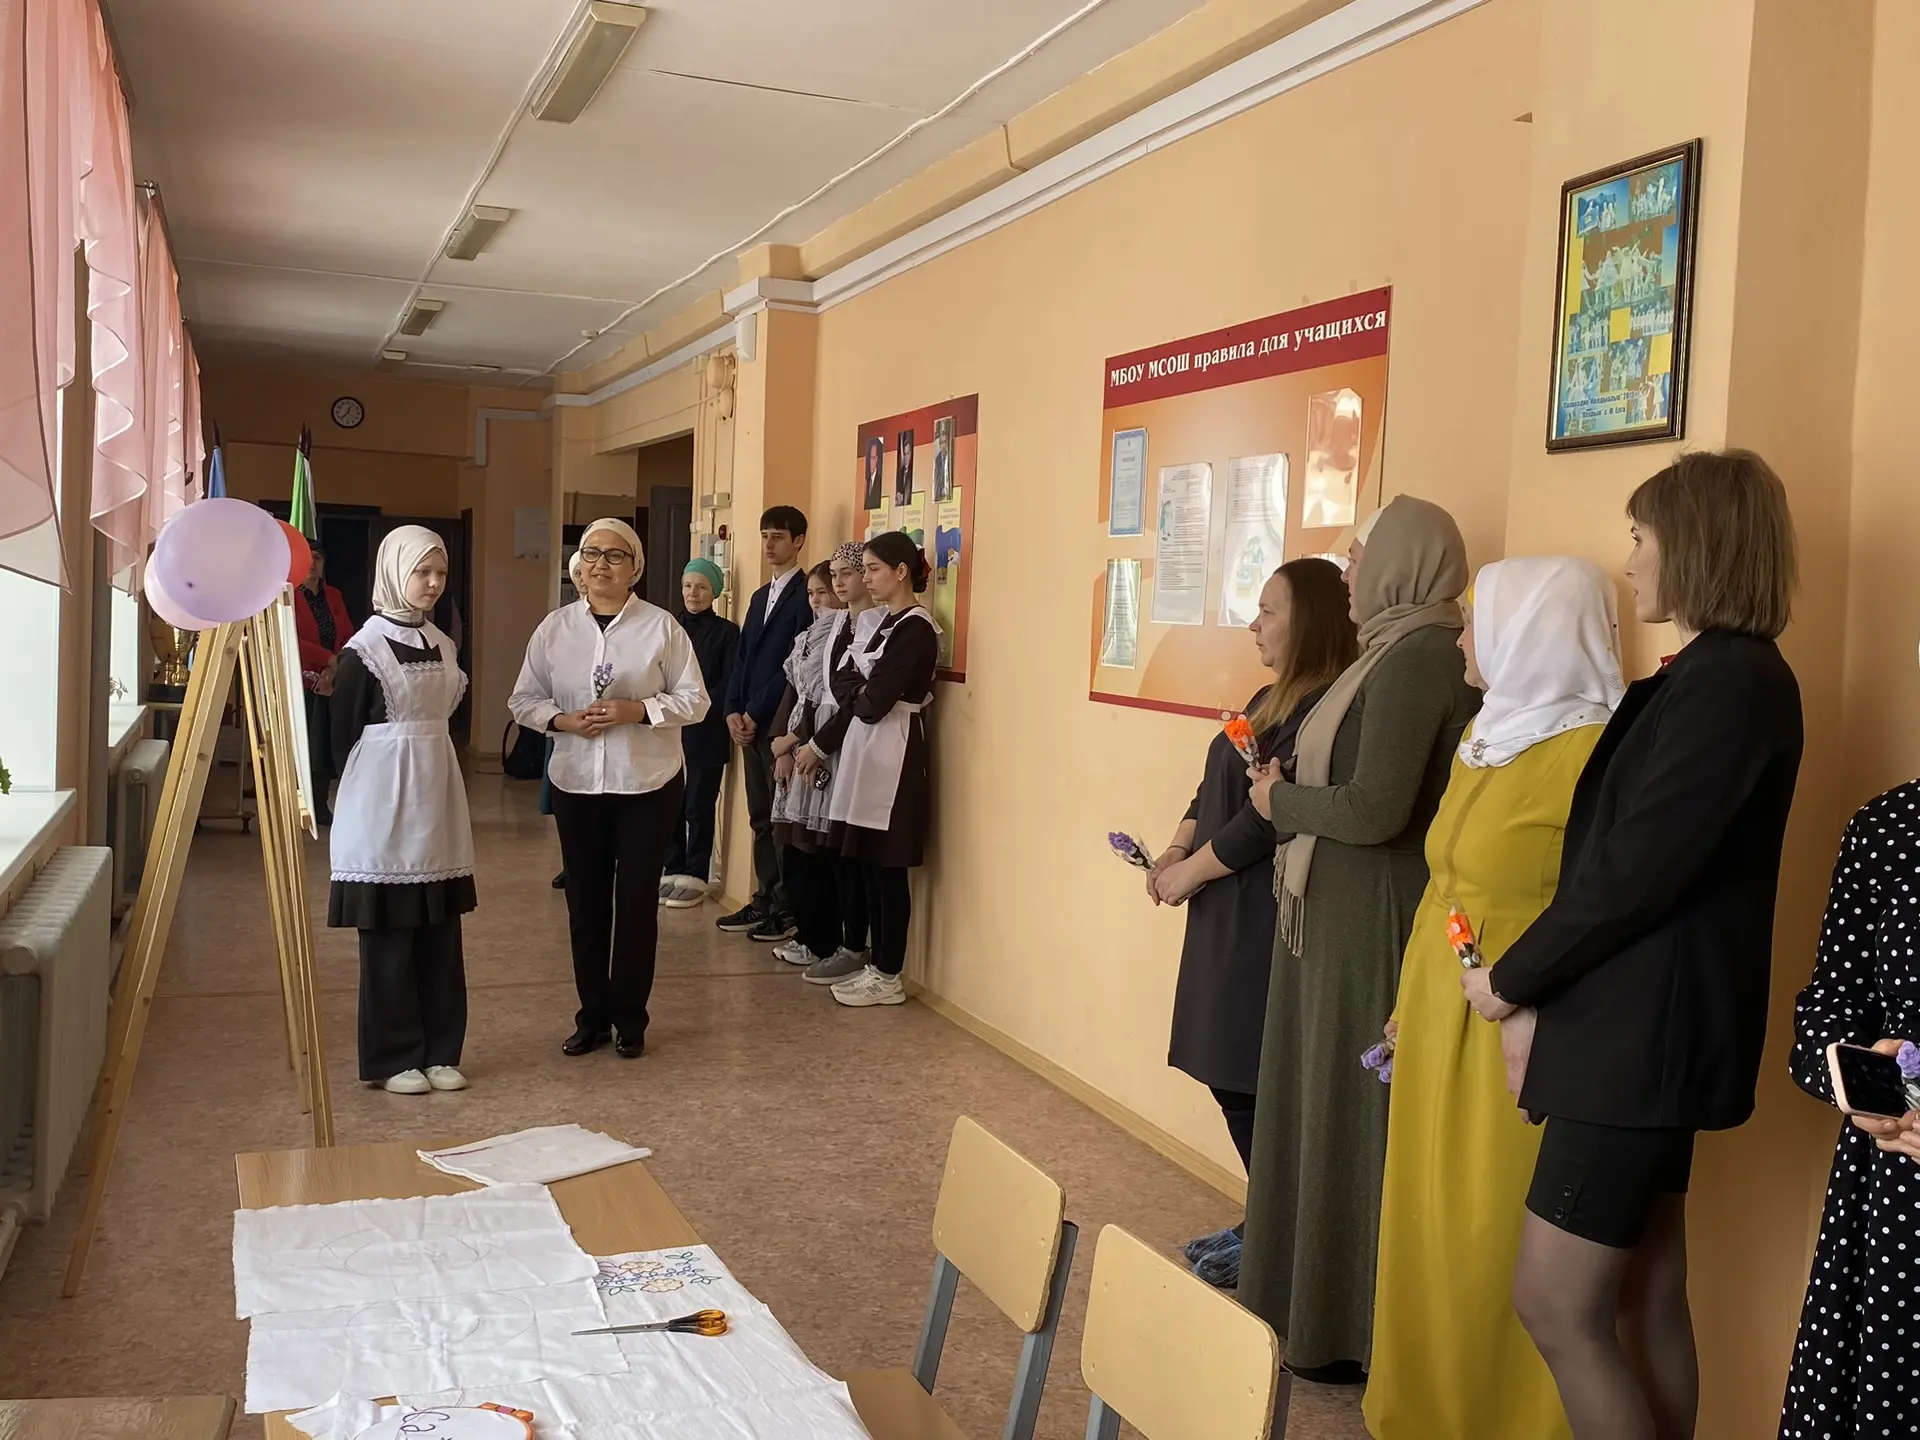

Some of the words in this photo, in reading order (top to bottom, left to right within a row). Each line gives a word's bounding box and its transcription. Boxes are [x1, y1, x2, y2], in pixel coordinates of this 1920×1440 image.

[1110, 363, 1144, 387] МБОУ
[1148, 353, 1190, 380] МСОШ
[1193, 341, 1255, 372] правила
[1258, 332, 1289, 357] для
[1293, 310, 1387, 351] учащихся
